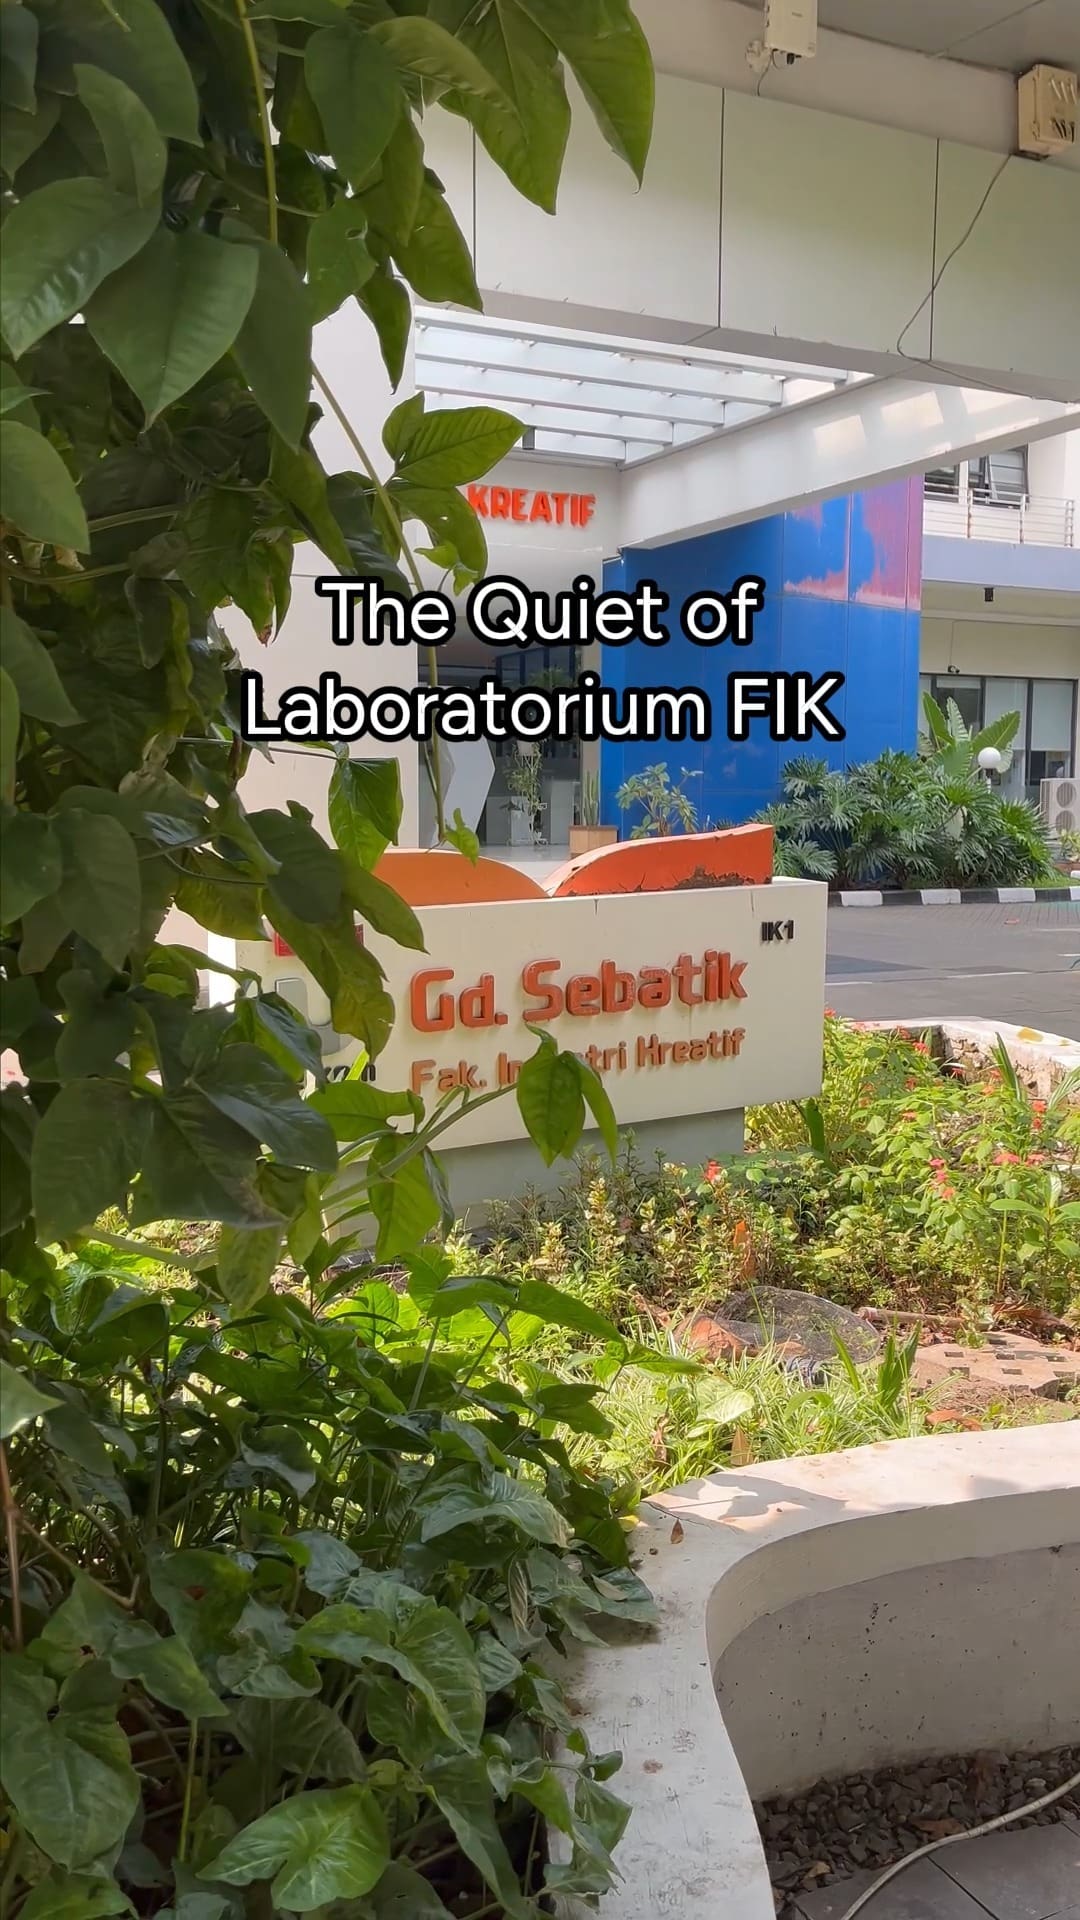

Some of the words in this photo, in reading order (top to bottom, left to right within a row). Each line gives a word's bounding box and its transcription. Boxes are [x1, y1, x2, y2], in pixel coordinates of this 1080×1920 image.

[467, 483, 596, 528] KREATIF
[761, 919, 795, 941] IK1
[410, 968, 508, 1033] Gd.
[522, 950, 748, 1022] Sebatik
[411, 1059, 487, 1095] Fak.
[496, 1041, 627, 1086] Intri
